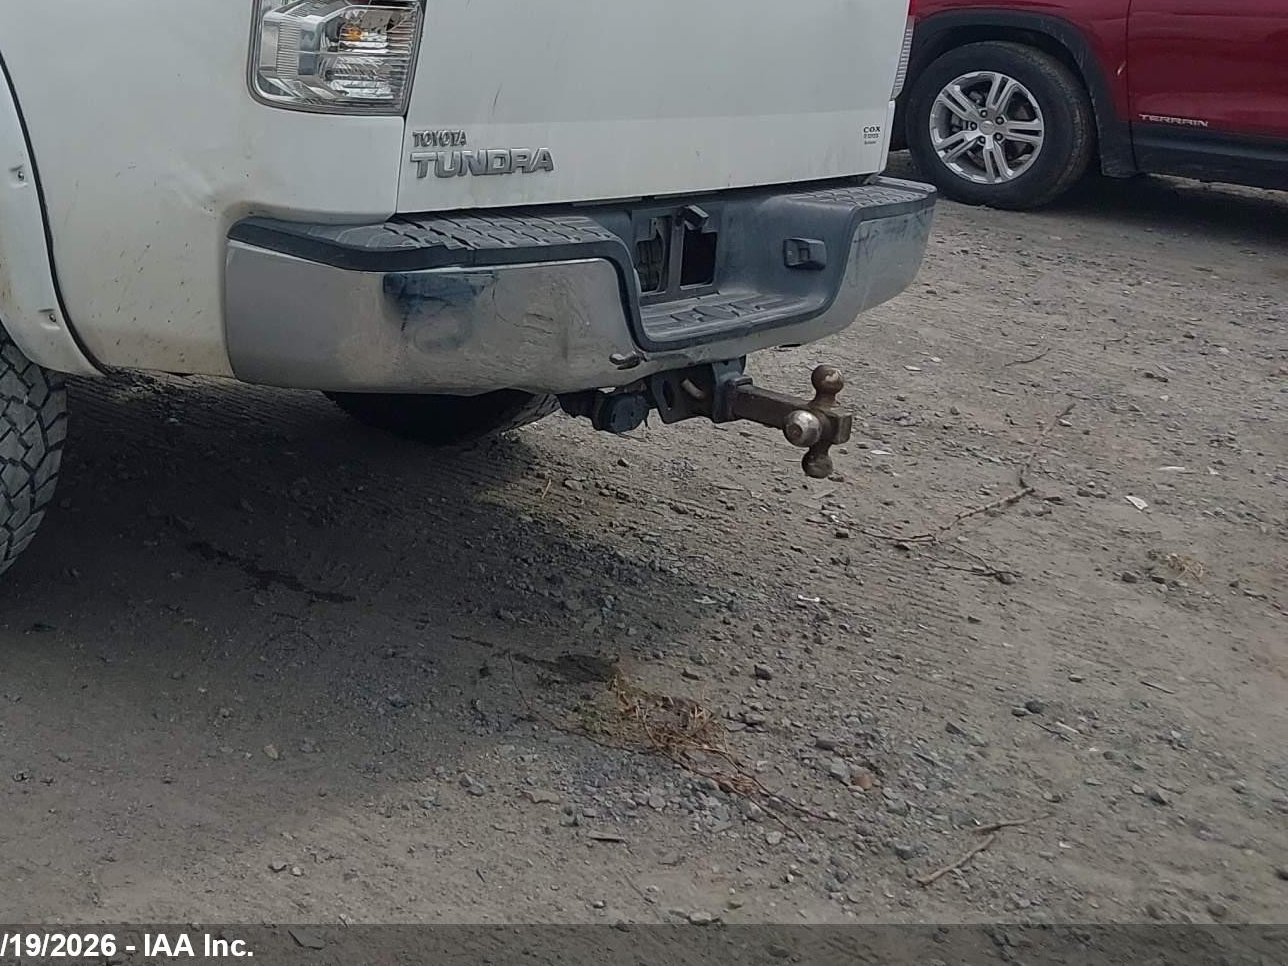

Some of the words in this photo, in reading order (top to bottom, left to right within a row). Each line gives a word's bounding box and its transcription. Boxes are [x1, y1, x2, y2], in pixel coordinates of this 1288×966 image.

[1138, 114, 1209, 127] TERRAIN
[412, 130, 467, 147] TOYOTA
[410, 148, 554, 179] TUNDRA
